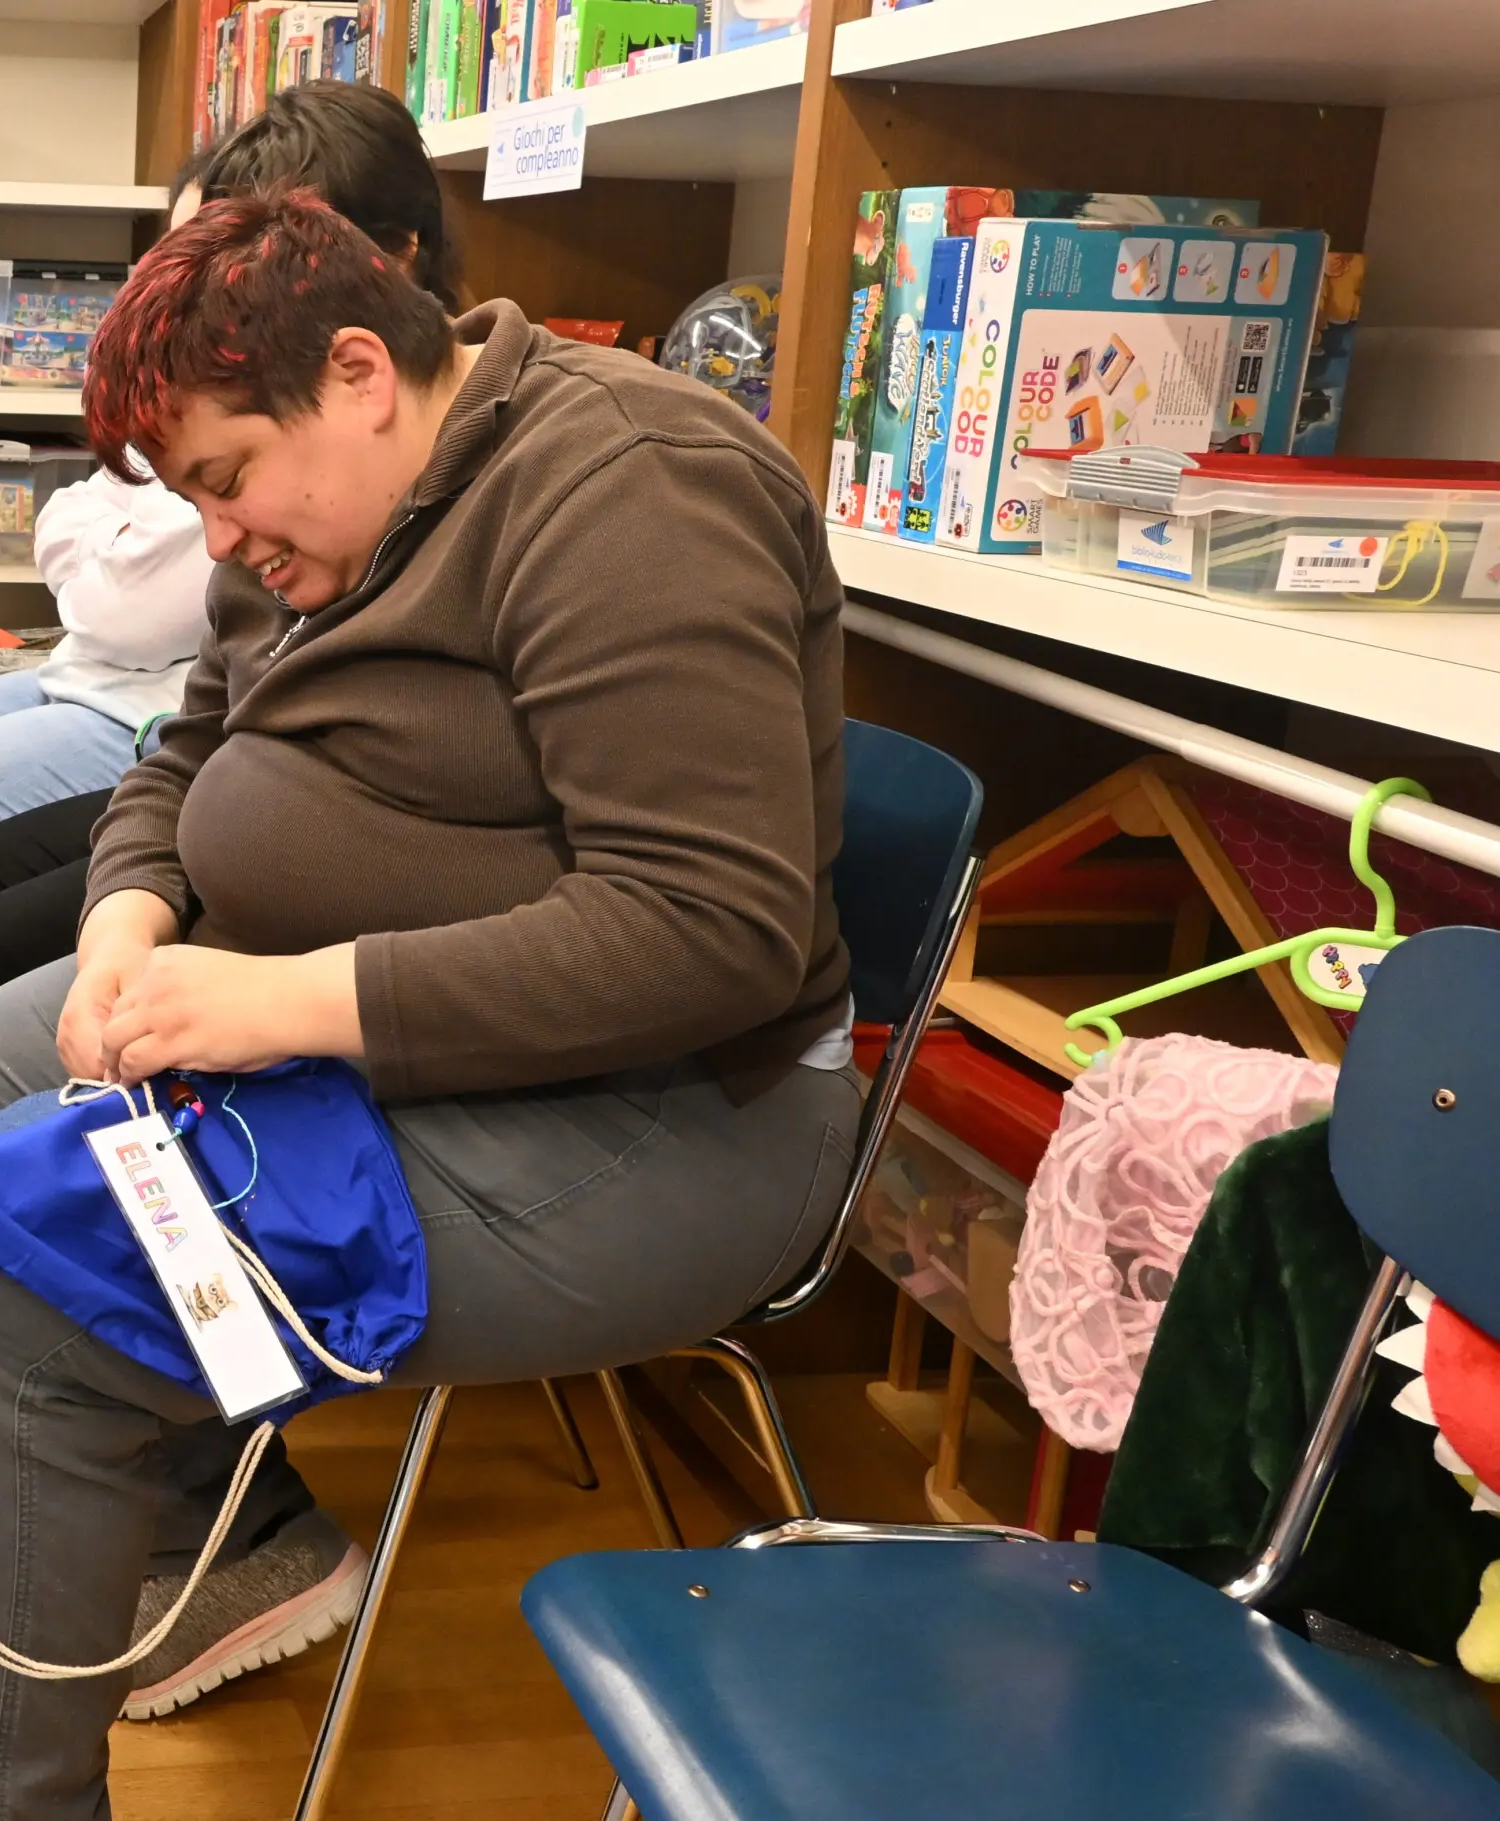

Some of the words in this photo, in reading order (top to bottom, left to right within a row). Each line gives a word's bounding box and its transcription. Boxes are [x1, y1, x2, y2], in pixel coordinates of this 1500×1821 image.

[514, 121, 546, 150] Giochi
[547, 123, 566, 146] per
[516, 146, 579, 177] compleanno
[1030, 258, 1038, 271] TO
[1032, 233, 1042, 257] PLAY
[952, 242, 969, 325] Ravensburger
[1025, 272, 1036, 296] HOW
[940, 333, 952, 387] JUNIOR
[969, 319, 1000, 458] COLOUR
[1036, 356, 1060, 423] CODE
[954, 386, 975, 454] COD
[1027, 499, 1038, 534] SMART
[116, 1142, 188, 1252] ELENA
